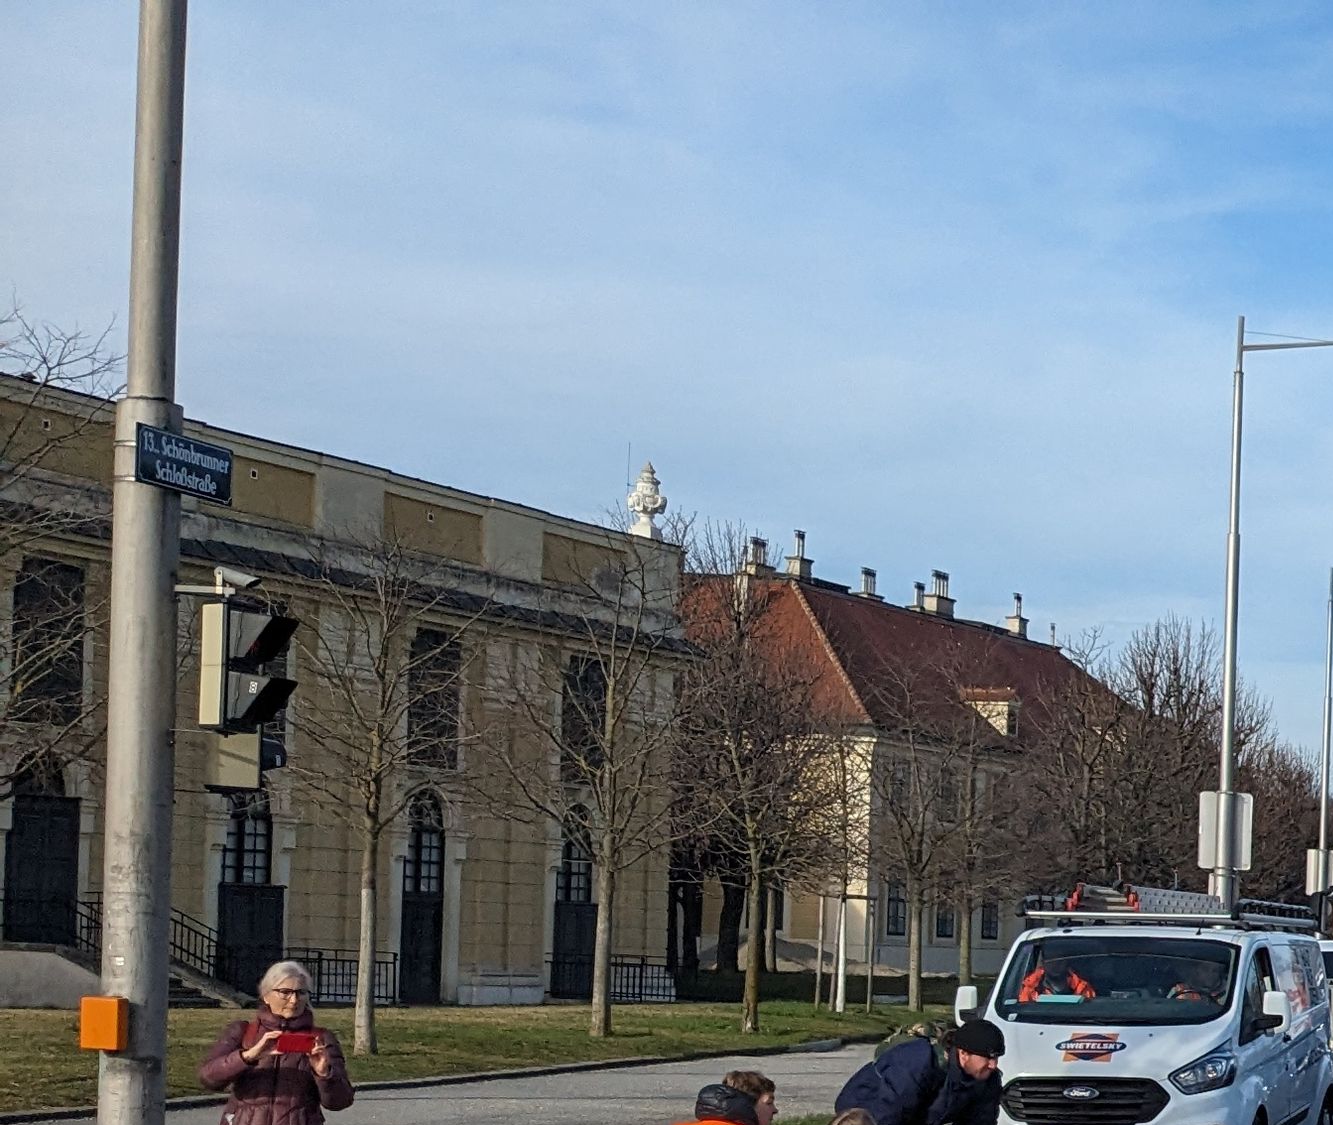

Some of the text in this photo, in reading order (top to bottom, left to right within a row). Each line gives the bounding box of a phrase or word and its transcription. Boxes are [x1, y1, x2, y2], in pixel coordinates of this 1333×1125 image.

[162, 436, 230, 474] Schönbrunner
[156, 460, 217, 495] Schloßstraße
[1059, 1042, 1122, 1050] SWIETELSKY
[1069, 1089, 1091, 1098] Ford
